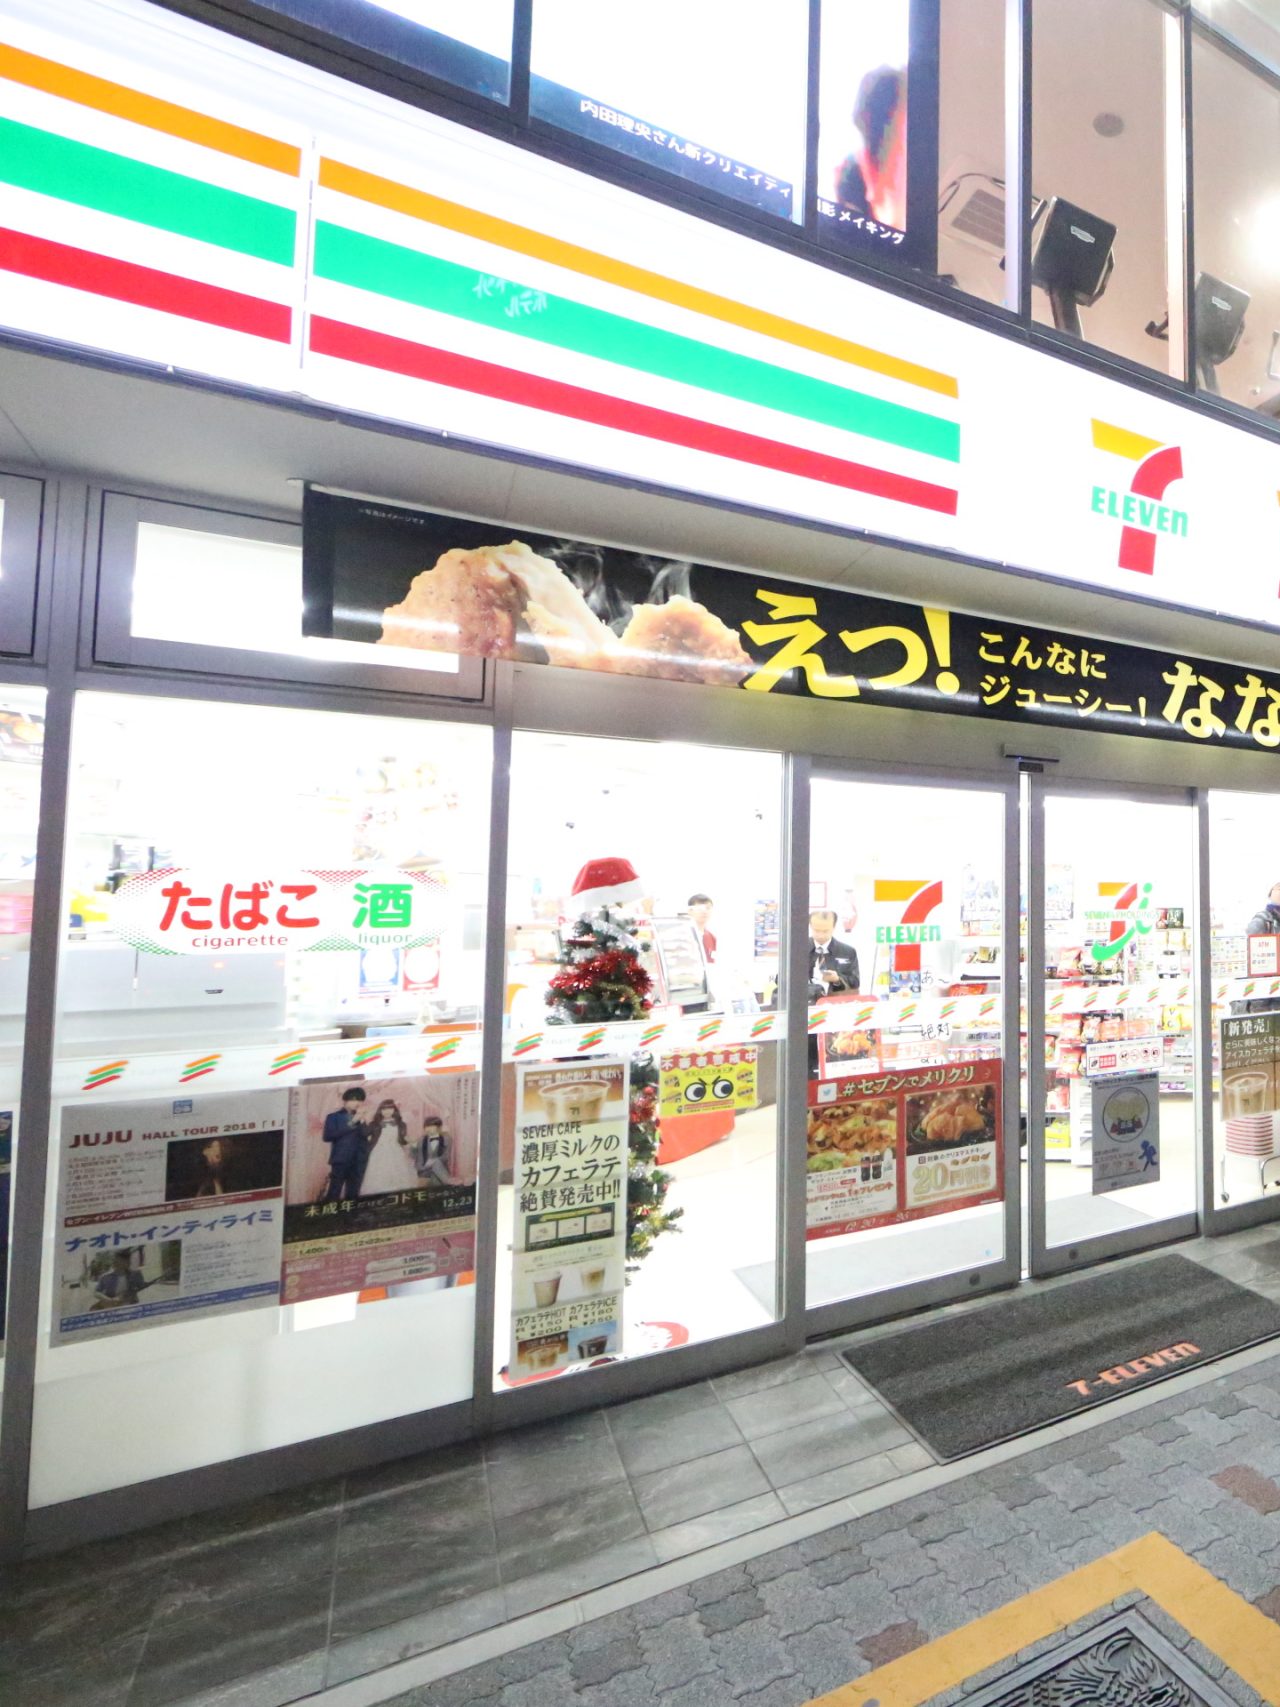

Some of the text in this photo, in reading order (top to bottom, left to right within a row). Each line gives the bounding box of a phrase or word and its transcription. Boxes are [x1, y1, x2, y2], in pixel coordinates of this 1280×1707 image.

[580, 99, 790, 198] 内田理央さん新クリエイティ
[1091, 485, 1189, 538] ELEVEN
[977, 630, 1108, 680] こんなに
[978, 672, 1148, 726] ジューシー!
[159, 881, 320, 931] たばこ
[353, 882, 414, 929] 酒
[191, 934, 288, 950] cigarette
[358, 933, 413, 946] liquor
[876, 924, 942, 944] ELEVEN
[69, 1130, 132, 1148] JUJU
[142, 1130, 177, 1141] HALL
[182, 1126, 218, 1137] TOUR
[223, 1121, 256, 1133] 2018
[522, 1123, 554, 1139] SEVEN
[522, 1135, 620, 1165] 濃厚ミルクの
[521, 1156, 622, 1189] カフェラテ
[65, 1209, 273, 1252] ナオト・インティライミ
